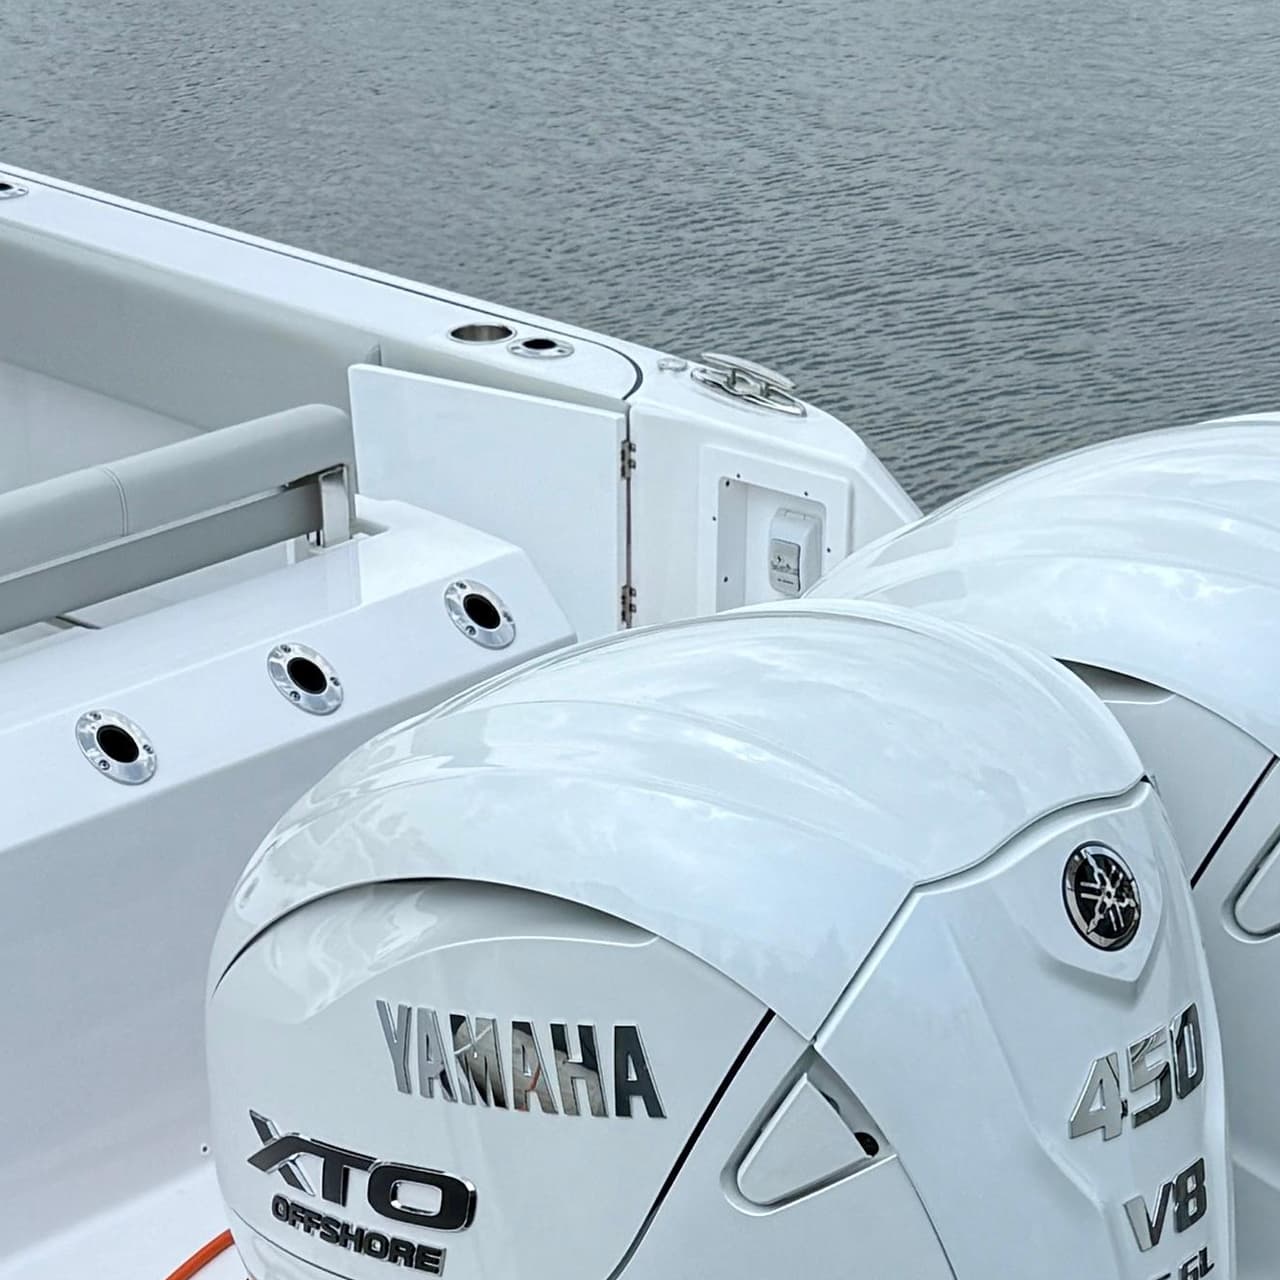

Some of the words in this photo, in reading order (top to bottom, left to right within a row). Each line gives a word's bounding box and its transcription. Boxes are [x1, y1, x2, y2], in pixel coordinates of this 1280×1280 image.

[375, 999, 667, 1119] YAMAHA
[1068, 1002, 1205, 1142] 450
[246, 1108, 478, 1232] XTO
[1123, 1157, 1208, 1253] V8
[271, 1193, 447, 1277] OFFSHORE
